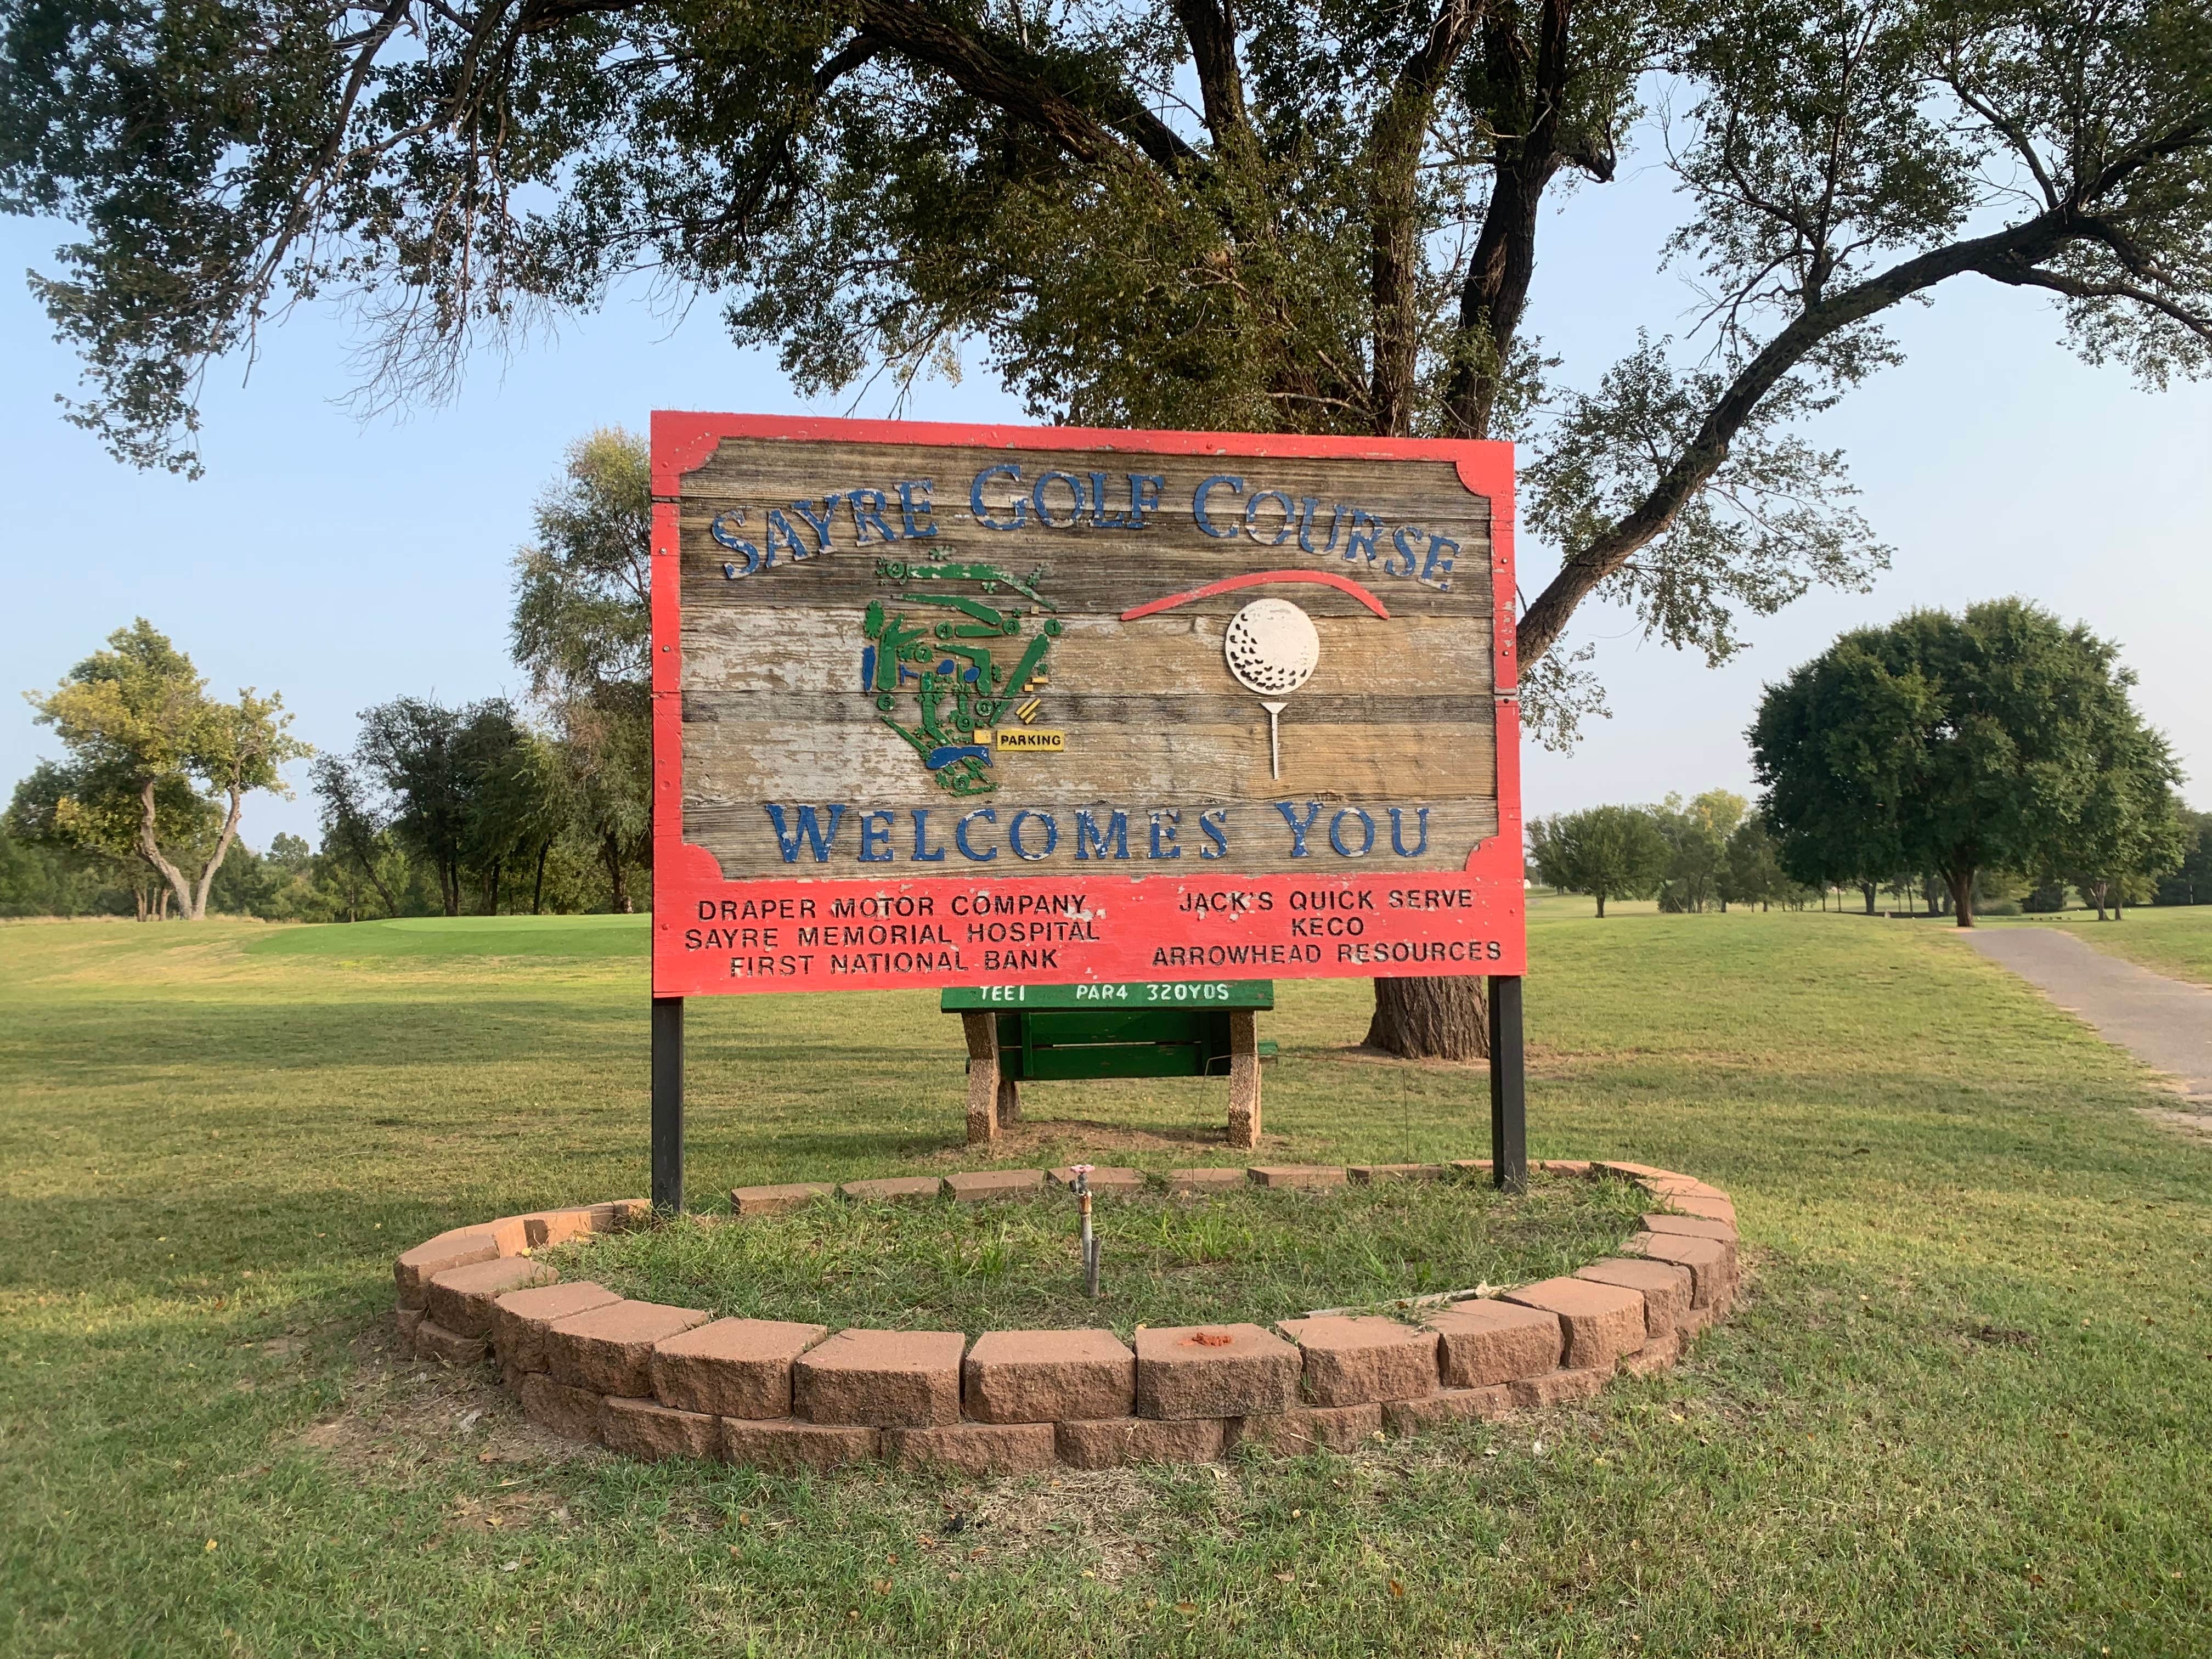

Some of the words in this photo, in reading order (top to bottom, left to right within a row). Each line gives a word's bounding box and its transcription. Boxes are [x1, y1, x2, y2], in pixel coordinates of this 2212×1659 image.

[711, 478, 939, 580] SAYRE
[969, 464, 1164, 531] GOLF
[1193, 475, 1463, 592] COURSE
[891, 565, 900, 573] 2
[940, 625, 949, 635] 4
[1008, 622, 1015, 631] 3
[920, 649, 927, 658] 7
[883, 697, 890, 707] 5
[962, 718, 970, 728] 9
[1001, 735, 1062, 746] PARKING
[958, 777, 966, 787] 6
[766, 804, 1228, 863] WELCOMES
[1276, 801, 1429, 858] YOU
[698, 899, 817, 922] DRAPER
[834, 896, 933, 918] MOTOR
[951, 895, 1086, 916] COMPANY
[1179, 890, 1273, 913] JACK'S
[1290, 890, 1374, 911] QUICK
[1389, 889, 1472, 909] SERVE
[684, 928, 779, 951] SAYRE
[799, 924, 952, 947] MEMORIAL
[967, 919, 1100, 943] HOSPITAL
[1291, 917, 1364, 937] KECO
[1152, 944, 1322, 967] ARROWHEAD
[1338, 941, 1502, 963] RESOURCES
[730, 955, 814, 978] FIRST
[830, 952, 969, 975] NATIONAL
[985, 949, 1059, 970] BANK
[1076, 984, 1128, 1000] PAR4
[1146, 984, 1229, 1001] 320YDS
